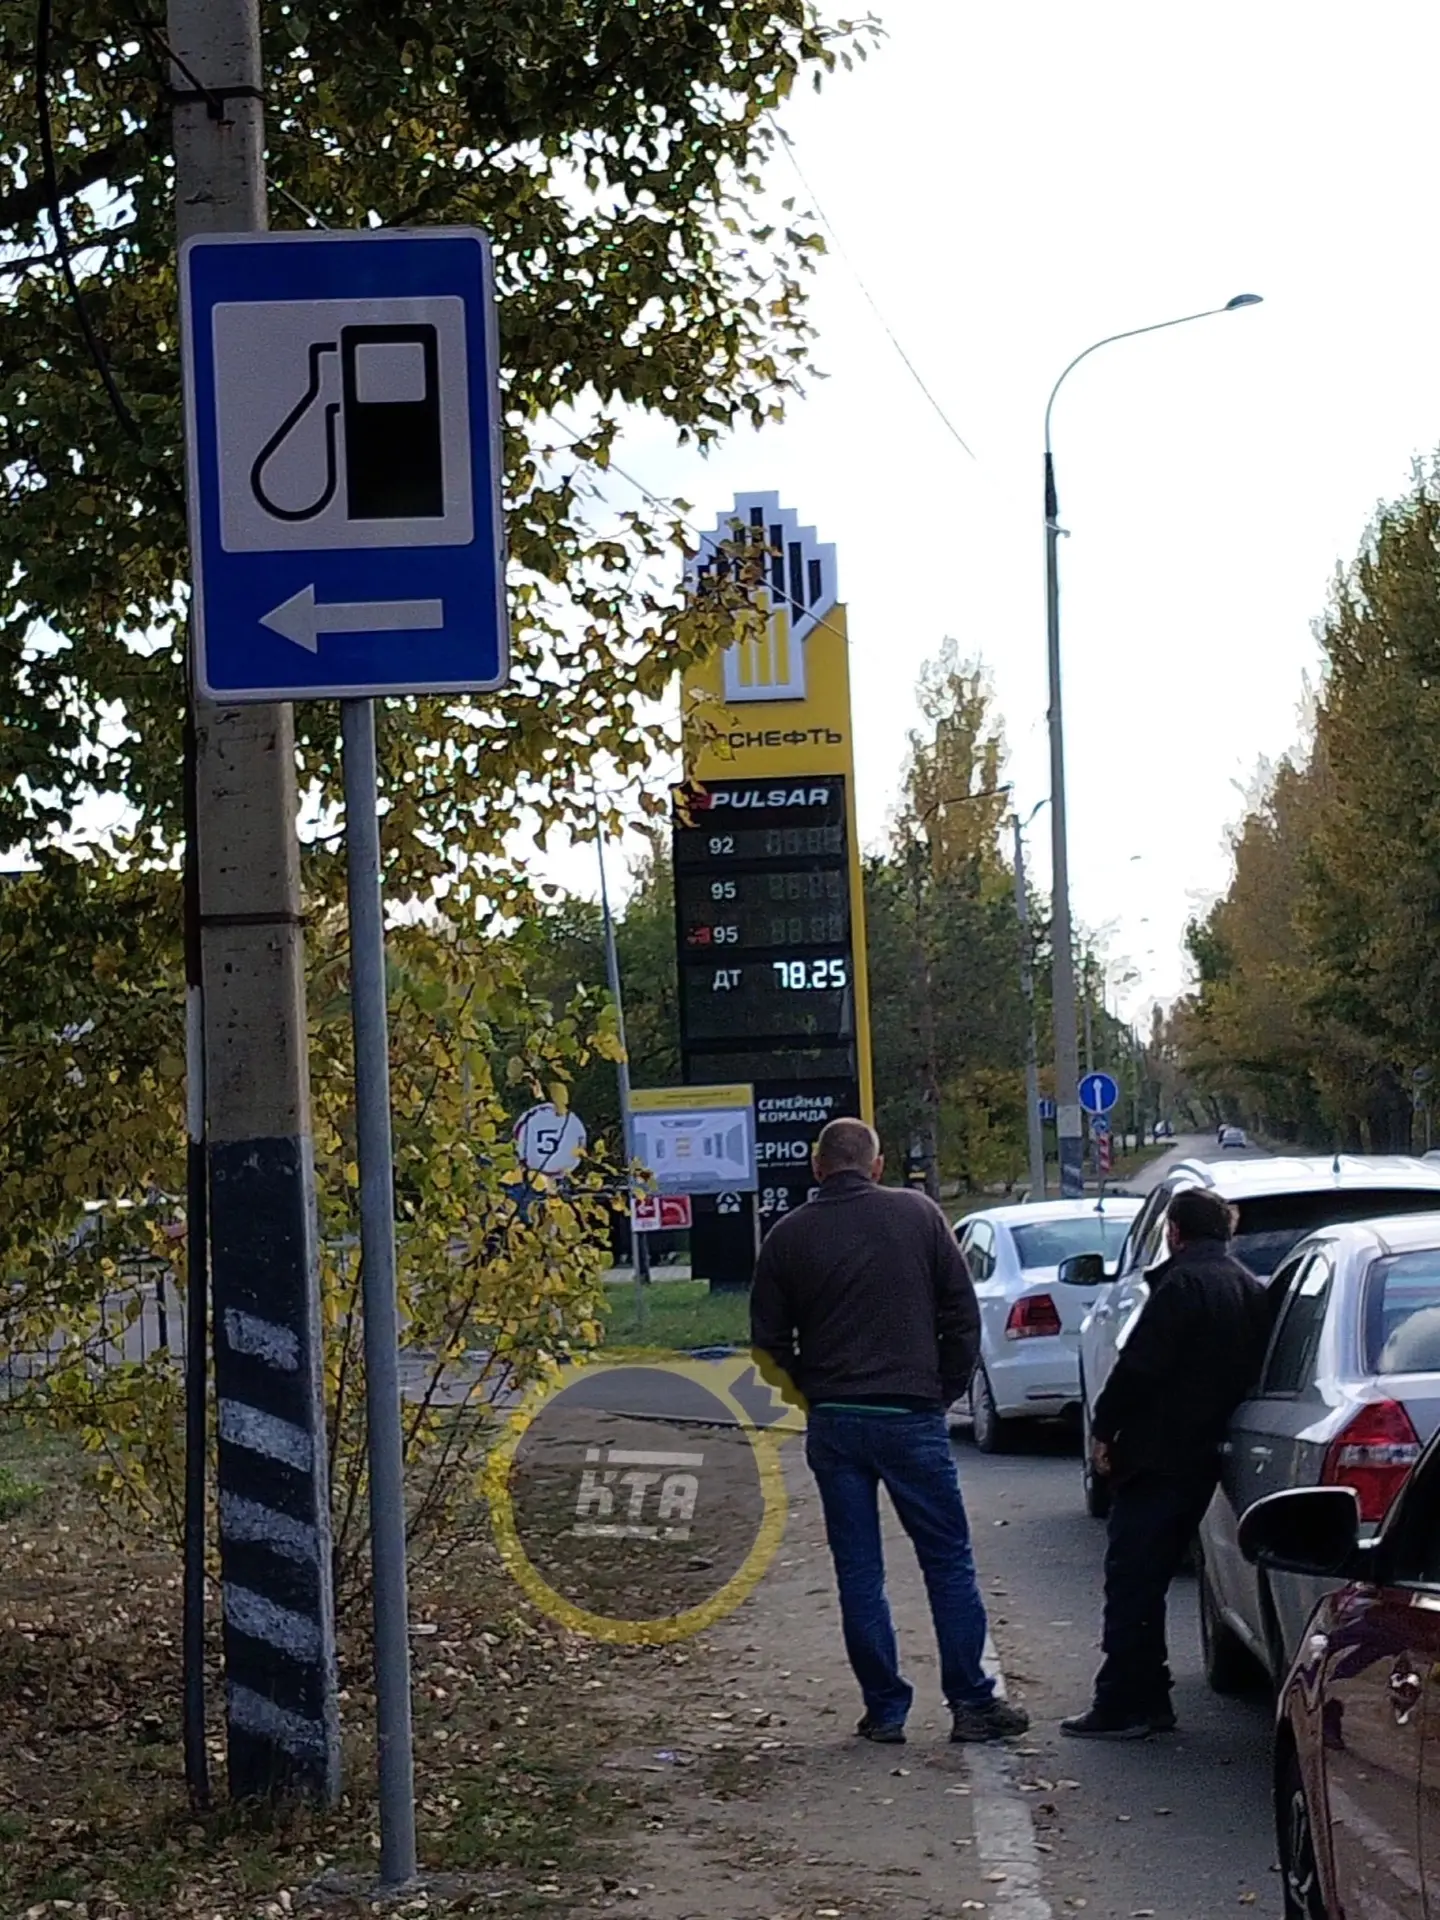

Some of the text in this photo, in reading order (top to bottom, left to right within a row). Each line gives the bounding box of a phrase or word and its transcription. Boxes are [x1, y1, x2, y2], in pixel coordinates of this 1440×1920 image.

[716, 728, 842, 749] СНЕФТЬ
[711, 788, 829, 810] PULSAR
[709, 836, 734, 854] 92
[711, 882, 736, 900] 95
[713, 926, 738, 944] 95
[713, 959, 846, 990] ДТ 78.25
[758, 1095, 833, 1110] СЕМЕЙНАЯ
[759, 1109, 828, 1122] КОМАНДА
[537, 1129, 560, 1155] 5
[755, 1141, 808, 1159] ЕРНО
